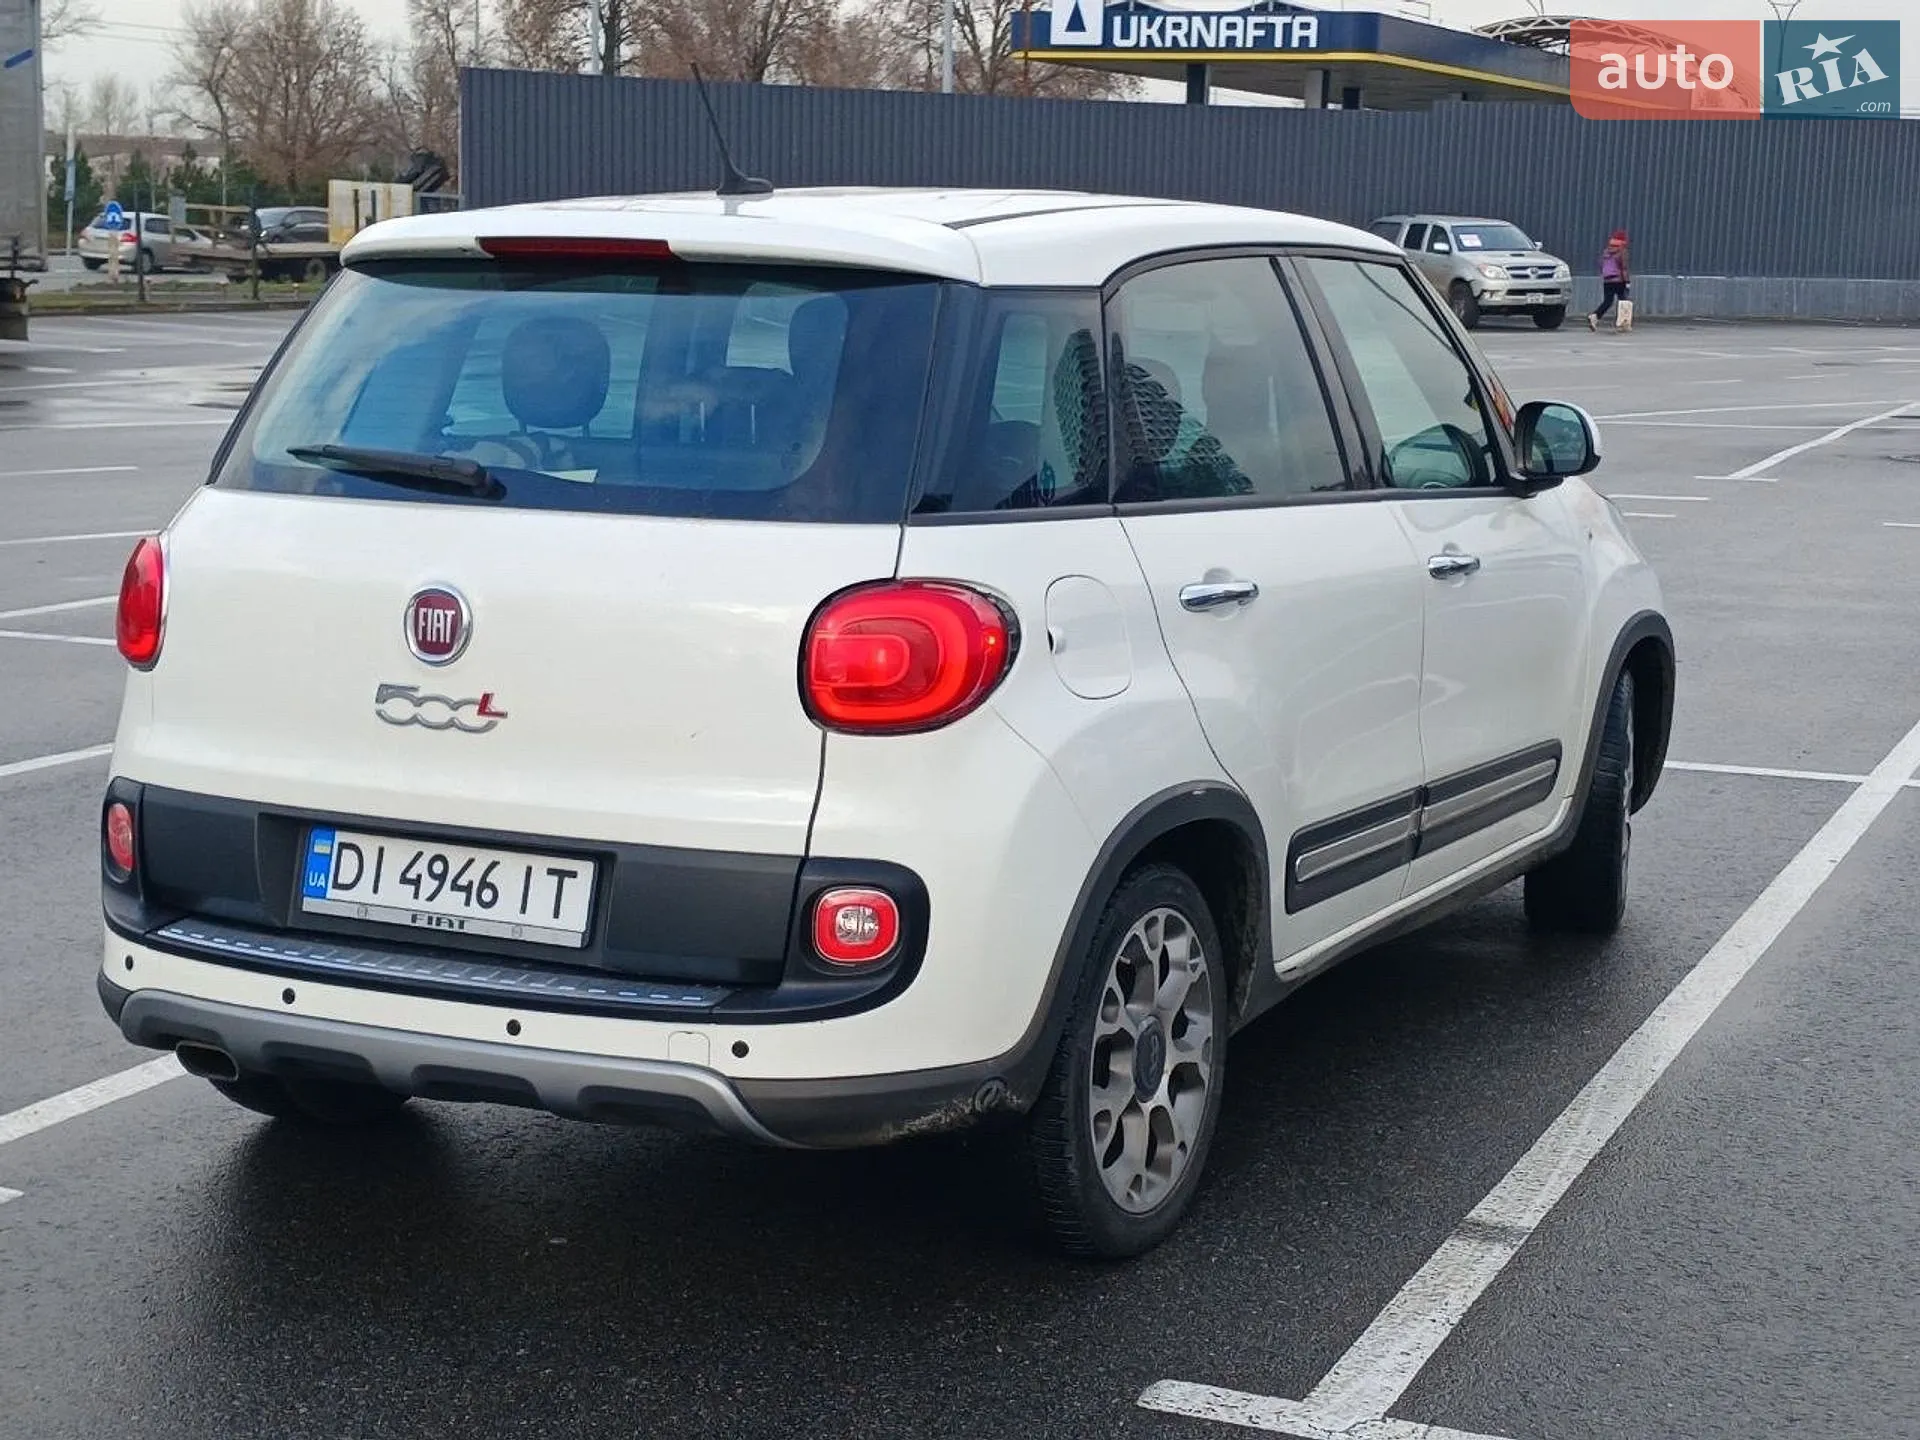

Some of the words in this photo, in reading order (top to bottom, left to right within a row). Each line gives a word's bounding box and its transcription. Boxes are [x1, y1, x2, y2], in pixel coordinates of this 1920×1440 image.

[1112, 15, 1319, 48] UKRNAFTA
[418, 607, 456, 644] FIAT
[375, 682, 508, 734] 500L
[308, 871, 327, 888] UA
[332, 841, 385, 895] DI
[399, 850, 501, 910] 4946
[519, 865, 579, 920] IT
[411, 913, 467, 930] FIAT
